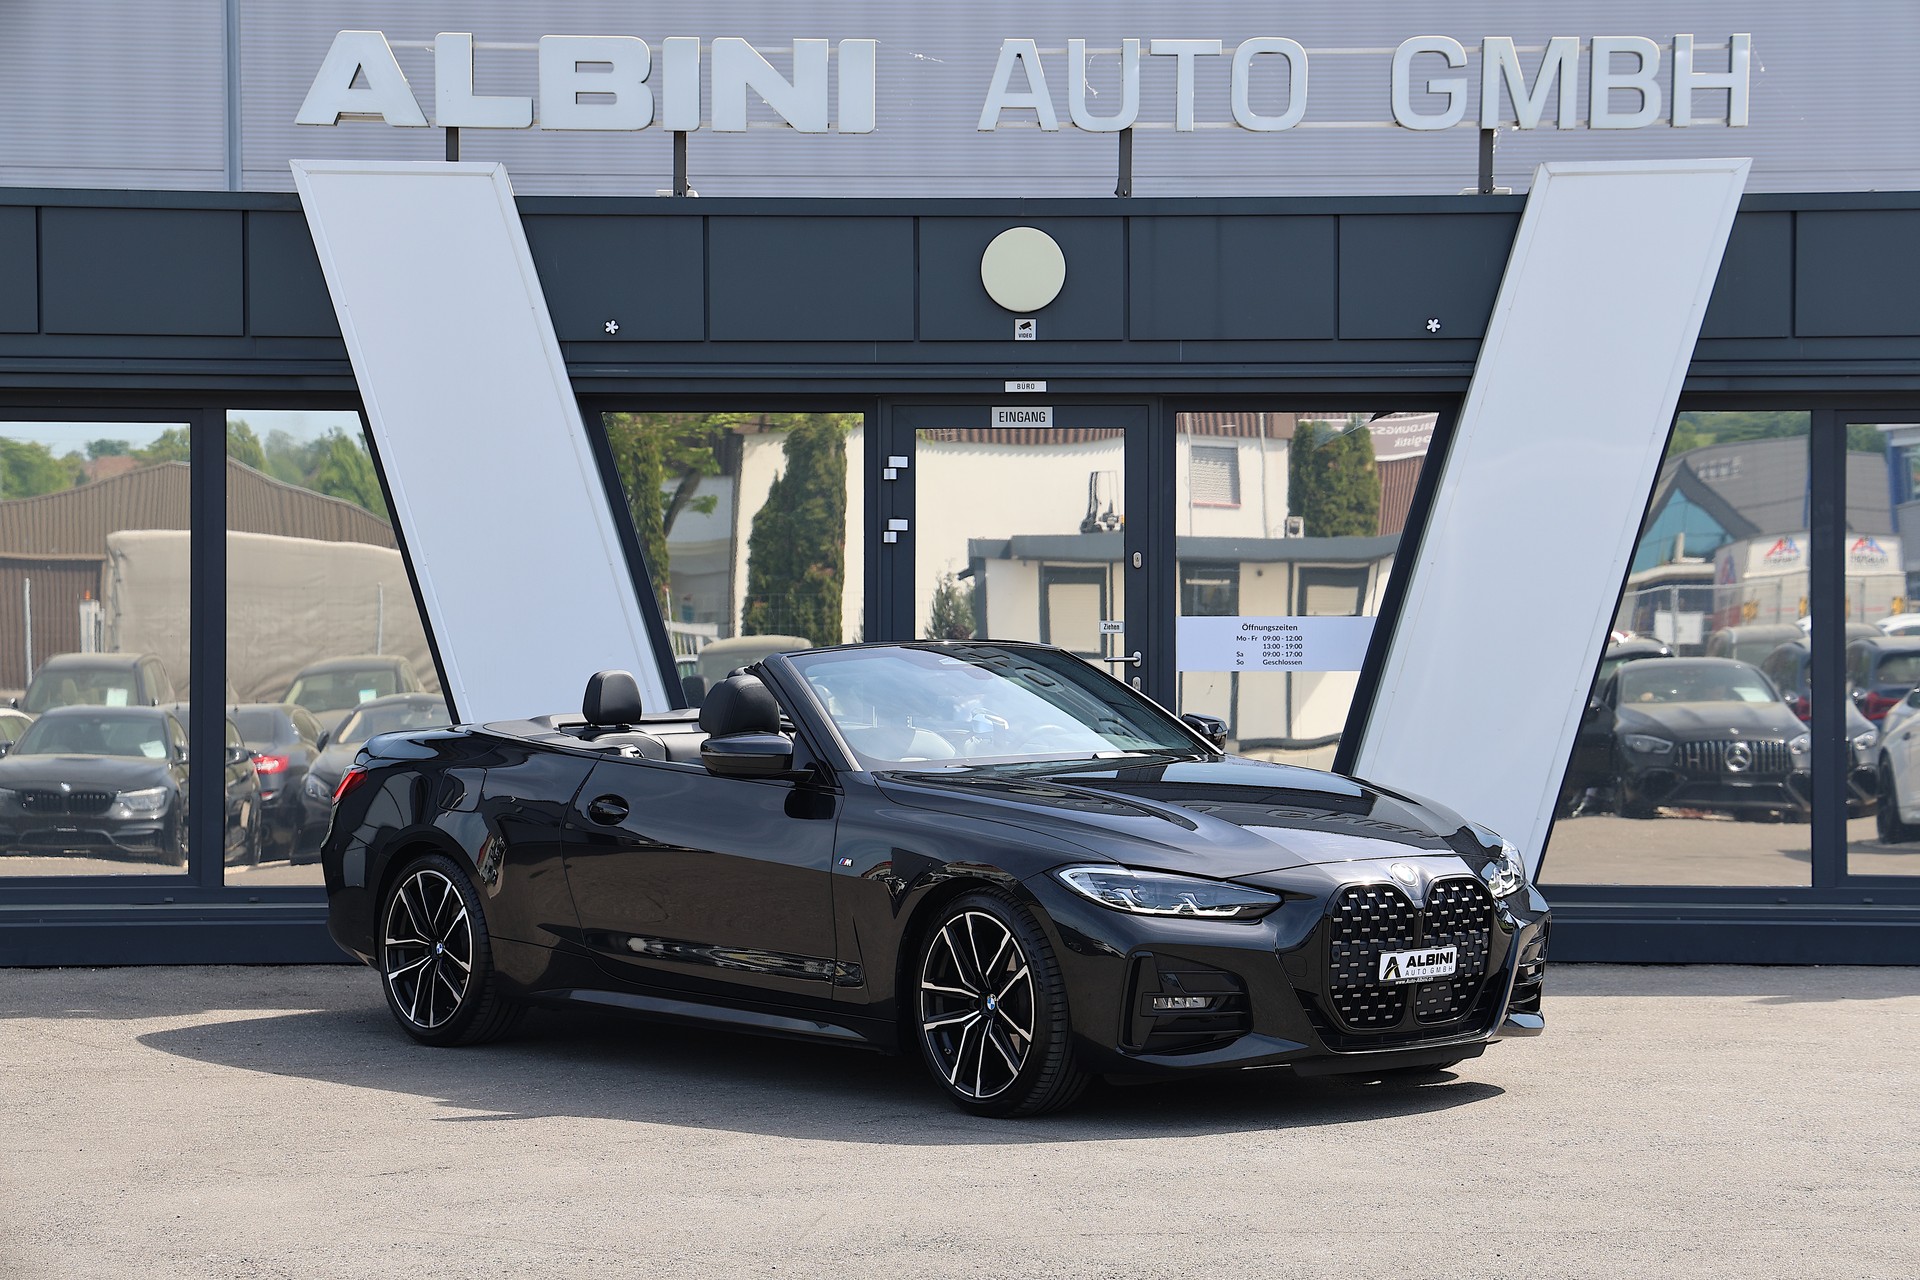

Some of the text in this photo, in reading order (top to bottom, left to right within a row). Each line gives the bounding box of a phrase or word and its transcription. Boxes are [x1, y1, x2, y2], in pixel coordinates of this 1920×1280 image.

[294, 29, 1751, 134] ALBINI AUTO GMBH
[1016, 382, 1035, 390] BÜRO
[999, 411, 1046, 423] EINGANG
[1241, 623, 1298, 632] Öffnungszeiten
[1406, 951, 1454, 968] ALBINI
[1405, 965, 1453, 977] AUTO GMBH
